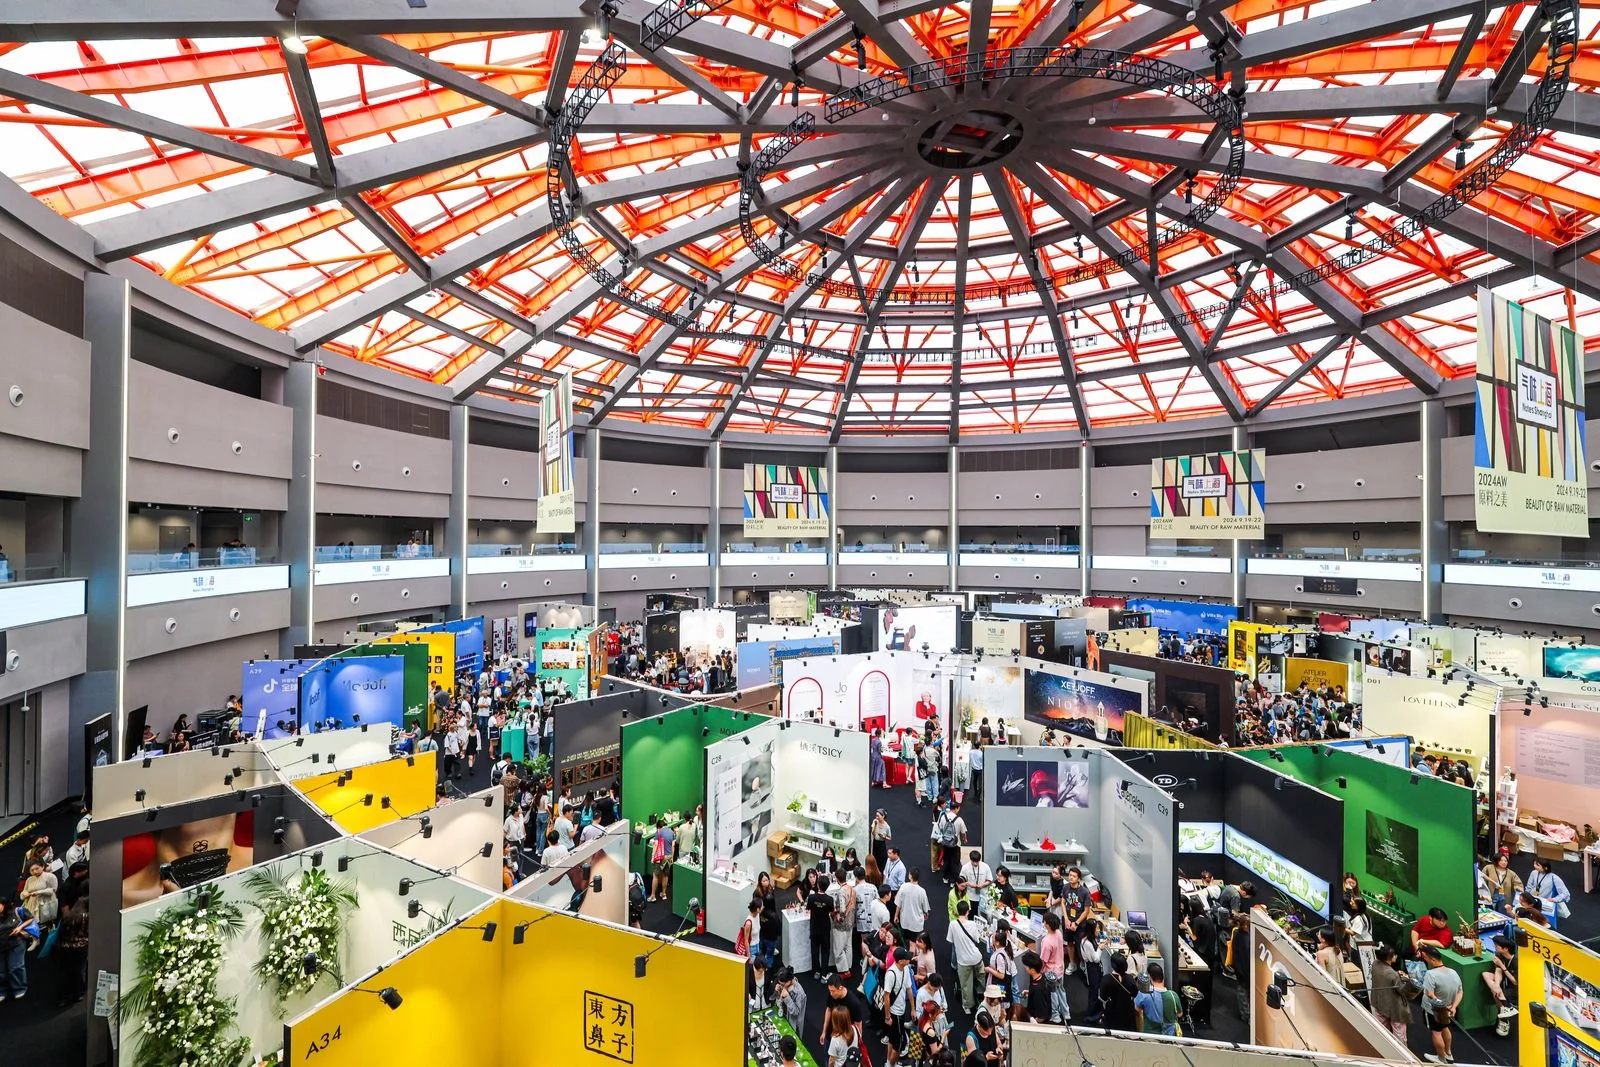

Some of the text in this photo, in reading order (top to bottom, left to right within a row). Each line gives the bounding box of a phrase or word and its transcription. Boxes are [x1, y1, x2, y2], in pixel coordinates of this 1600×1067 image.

[1522, 402, 1534, 414] Notes
[1478, 472, 1508, 486] 2024AW
[1478, 489, 1508, 508] 原料之美
[1526, 498, 1586, 515] BEAUTY OF RAW MATERIAL
[1301, 676, 1330, 684] CREATION
[711, 755, 722, 765] C28
[1158, 803, 1168, 816] C29
[1533, 940, 1562, 966] B36
[306, 1024, 341, 1060] A34
